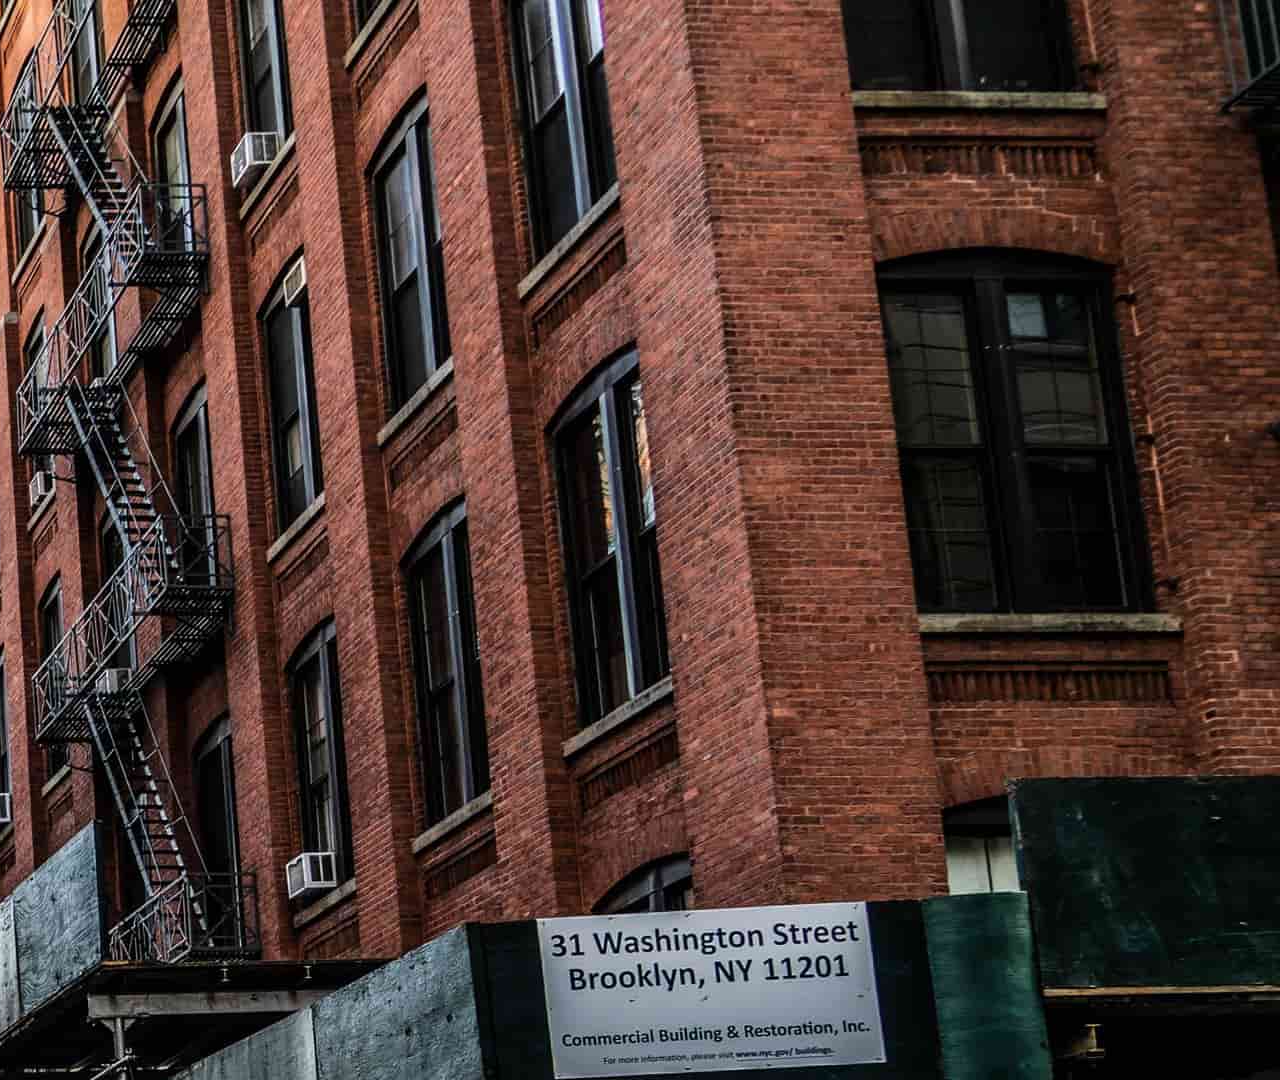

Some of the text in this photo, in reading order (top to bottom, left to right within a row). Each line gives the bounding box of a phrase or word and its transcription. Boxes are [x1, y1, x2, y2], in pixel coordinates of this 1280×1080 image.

[550, 920, 860, 957] 31 Washington Street
[568, 954, 850, 992] Brooklyn, NY 11201
[561, 1019, 870, 1048] Commercial Building & Restoration, Inc.
[603, 1056, 616, 1065] For
[618, 1057, 639, 1065] more
